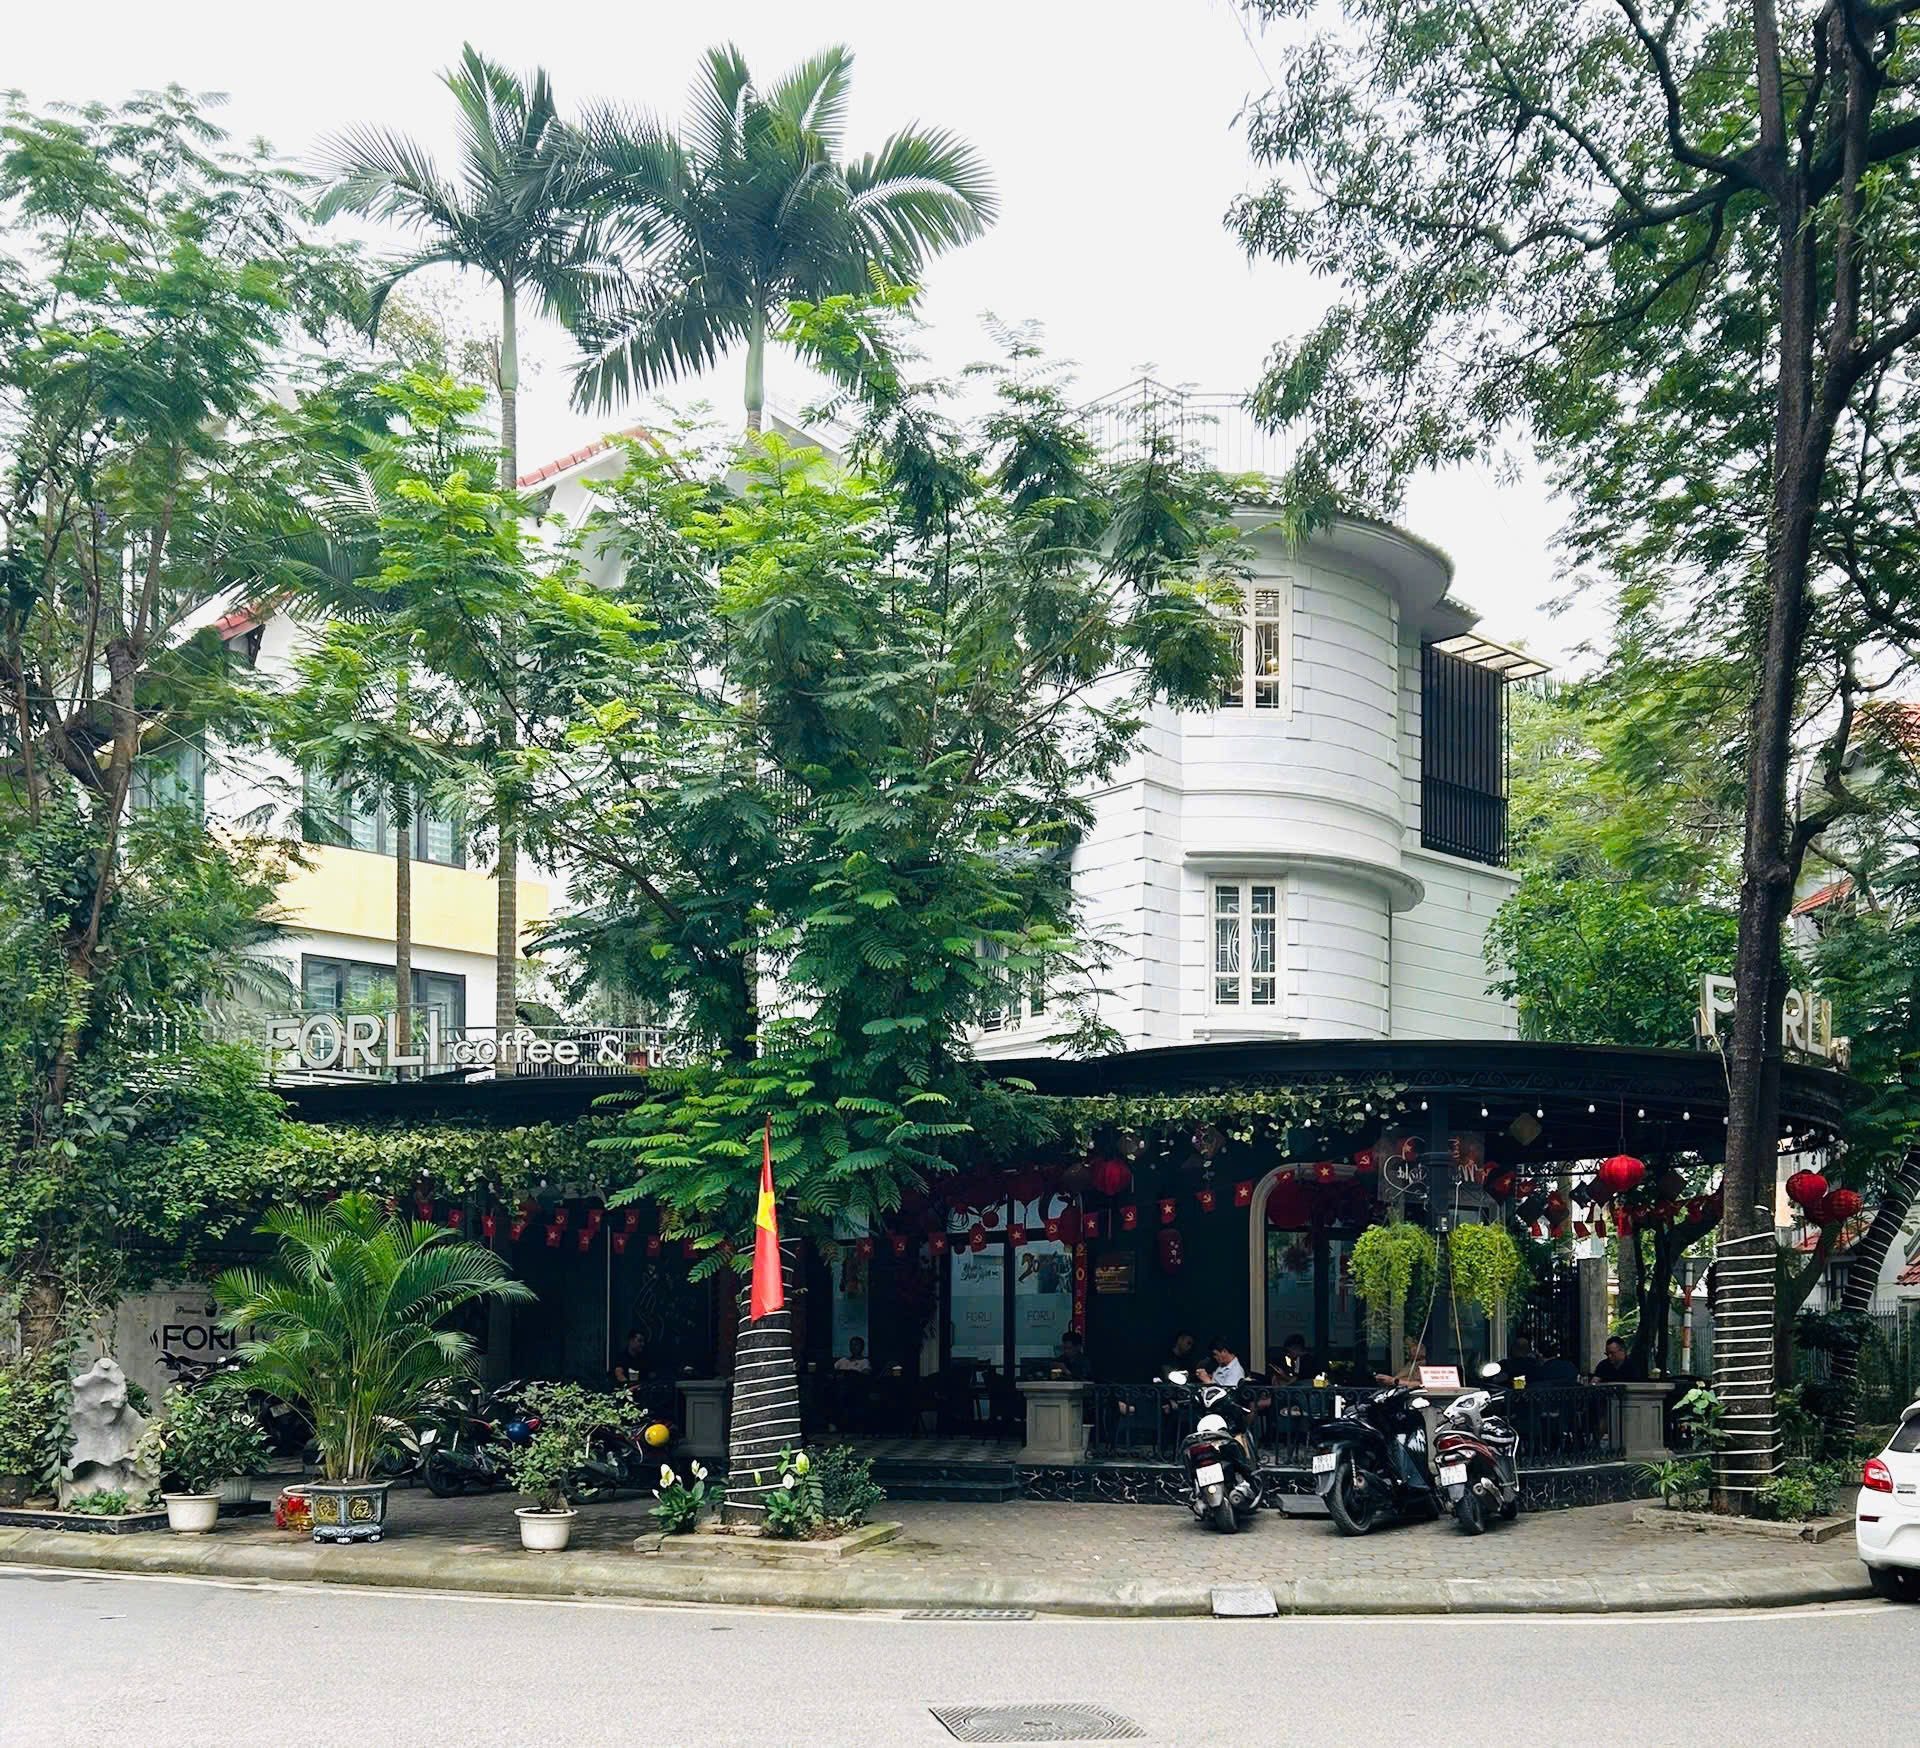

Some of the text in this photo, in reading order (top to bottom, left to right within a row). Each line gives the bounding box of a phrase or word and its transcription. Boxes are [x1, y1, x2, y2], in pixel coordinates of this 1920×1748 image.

[264, 1009, 439, 1069] FORLI
[452, 1029, 580, 1064] coffee
[597, 1034, 625, 1065] &
[1701, 973, 1832, 1060] FRLI
